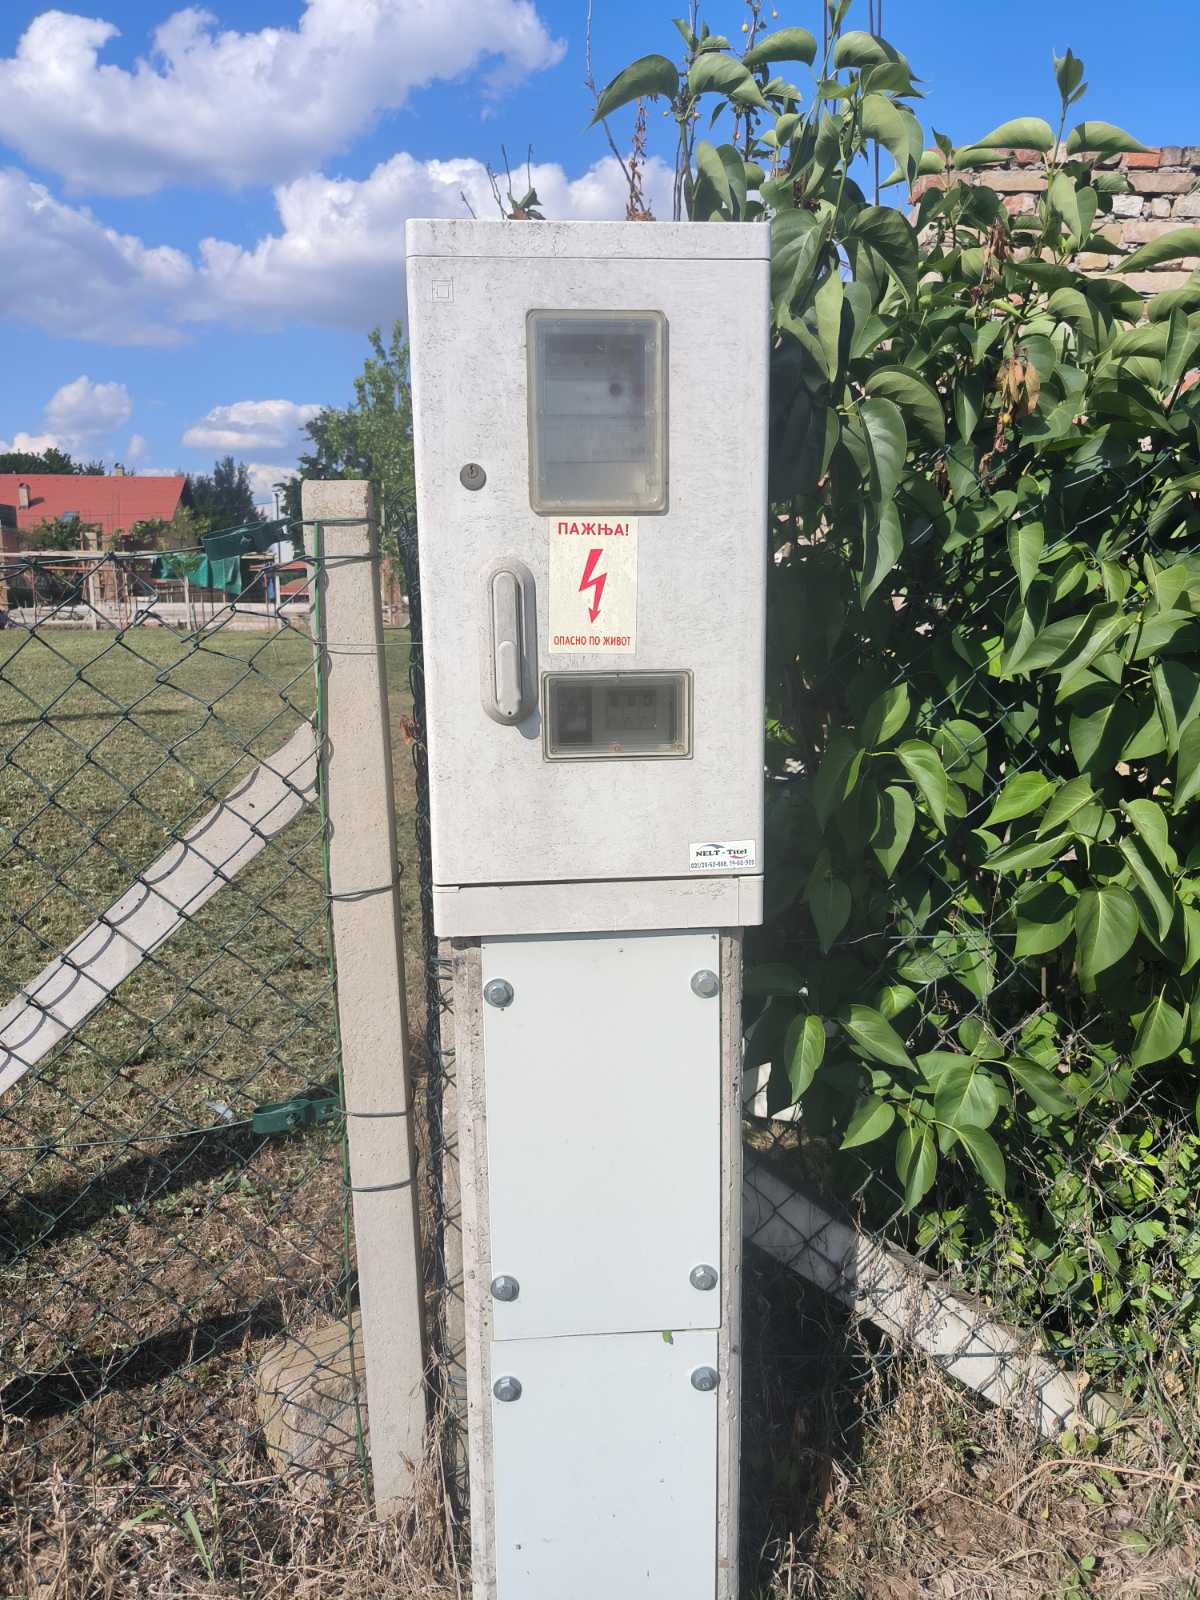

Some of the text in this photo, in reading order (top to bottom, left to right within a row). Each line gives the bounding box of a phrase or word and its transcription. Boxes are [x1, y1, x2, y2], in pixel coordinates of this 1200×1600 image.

[558, 522, 629, 536] ПАЖЊА!
[553, 636, 631, 646] ОПАСНО ПО ЖИВОТ
[696, 849, 720, 857] NELT
